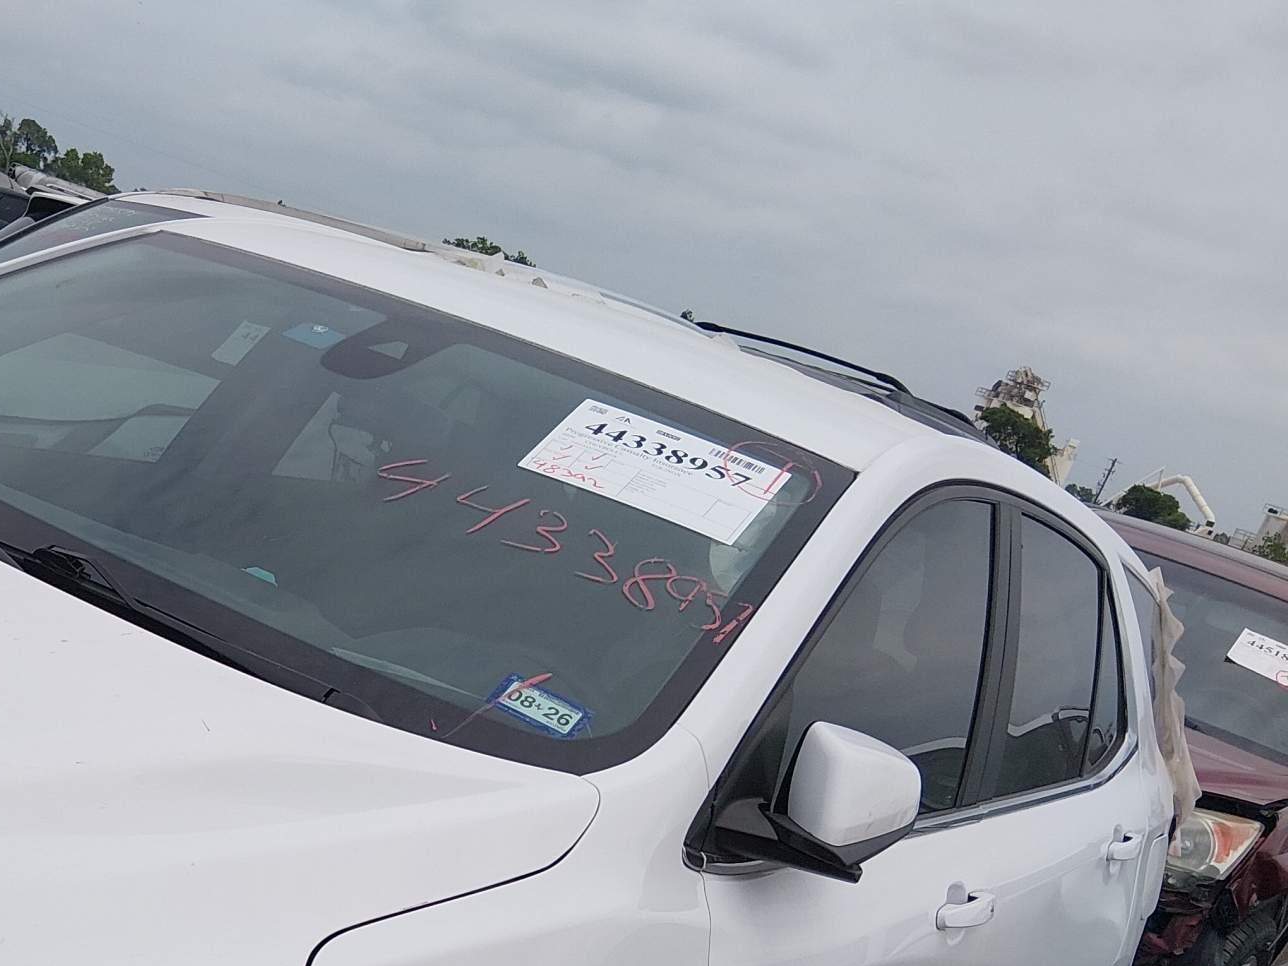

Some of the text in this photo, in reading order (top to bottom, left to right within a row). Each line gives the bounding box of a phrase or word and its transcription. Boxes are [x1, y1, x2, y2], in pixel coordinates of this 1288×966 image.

[584, 422, 752, 487] 44338957
[508, 689, 537, 709] 08
[542, 706, 573, 727] 26
